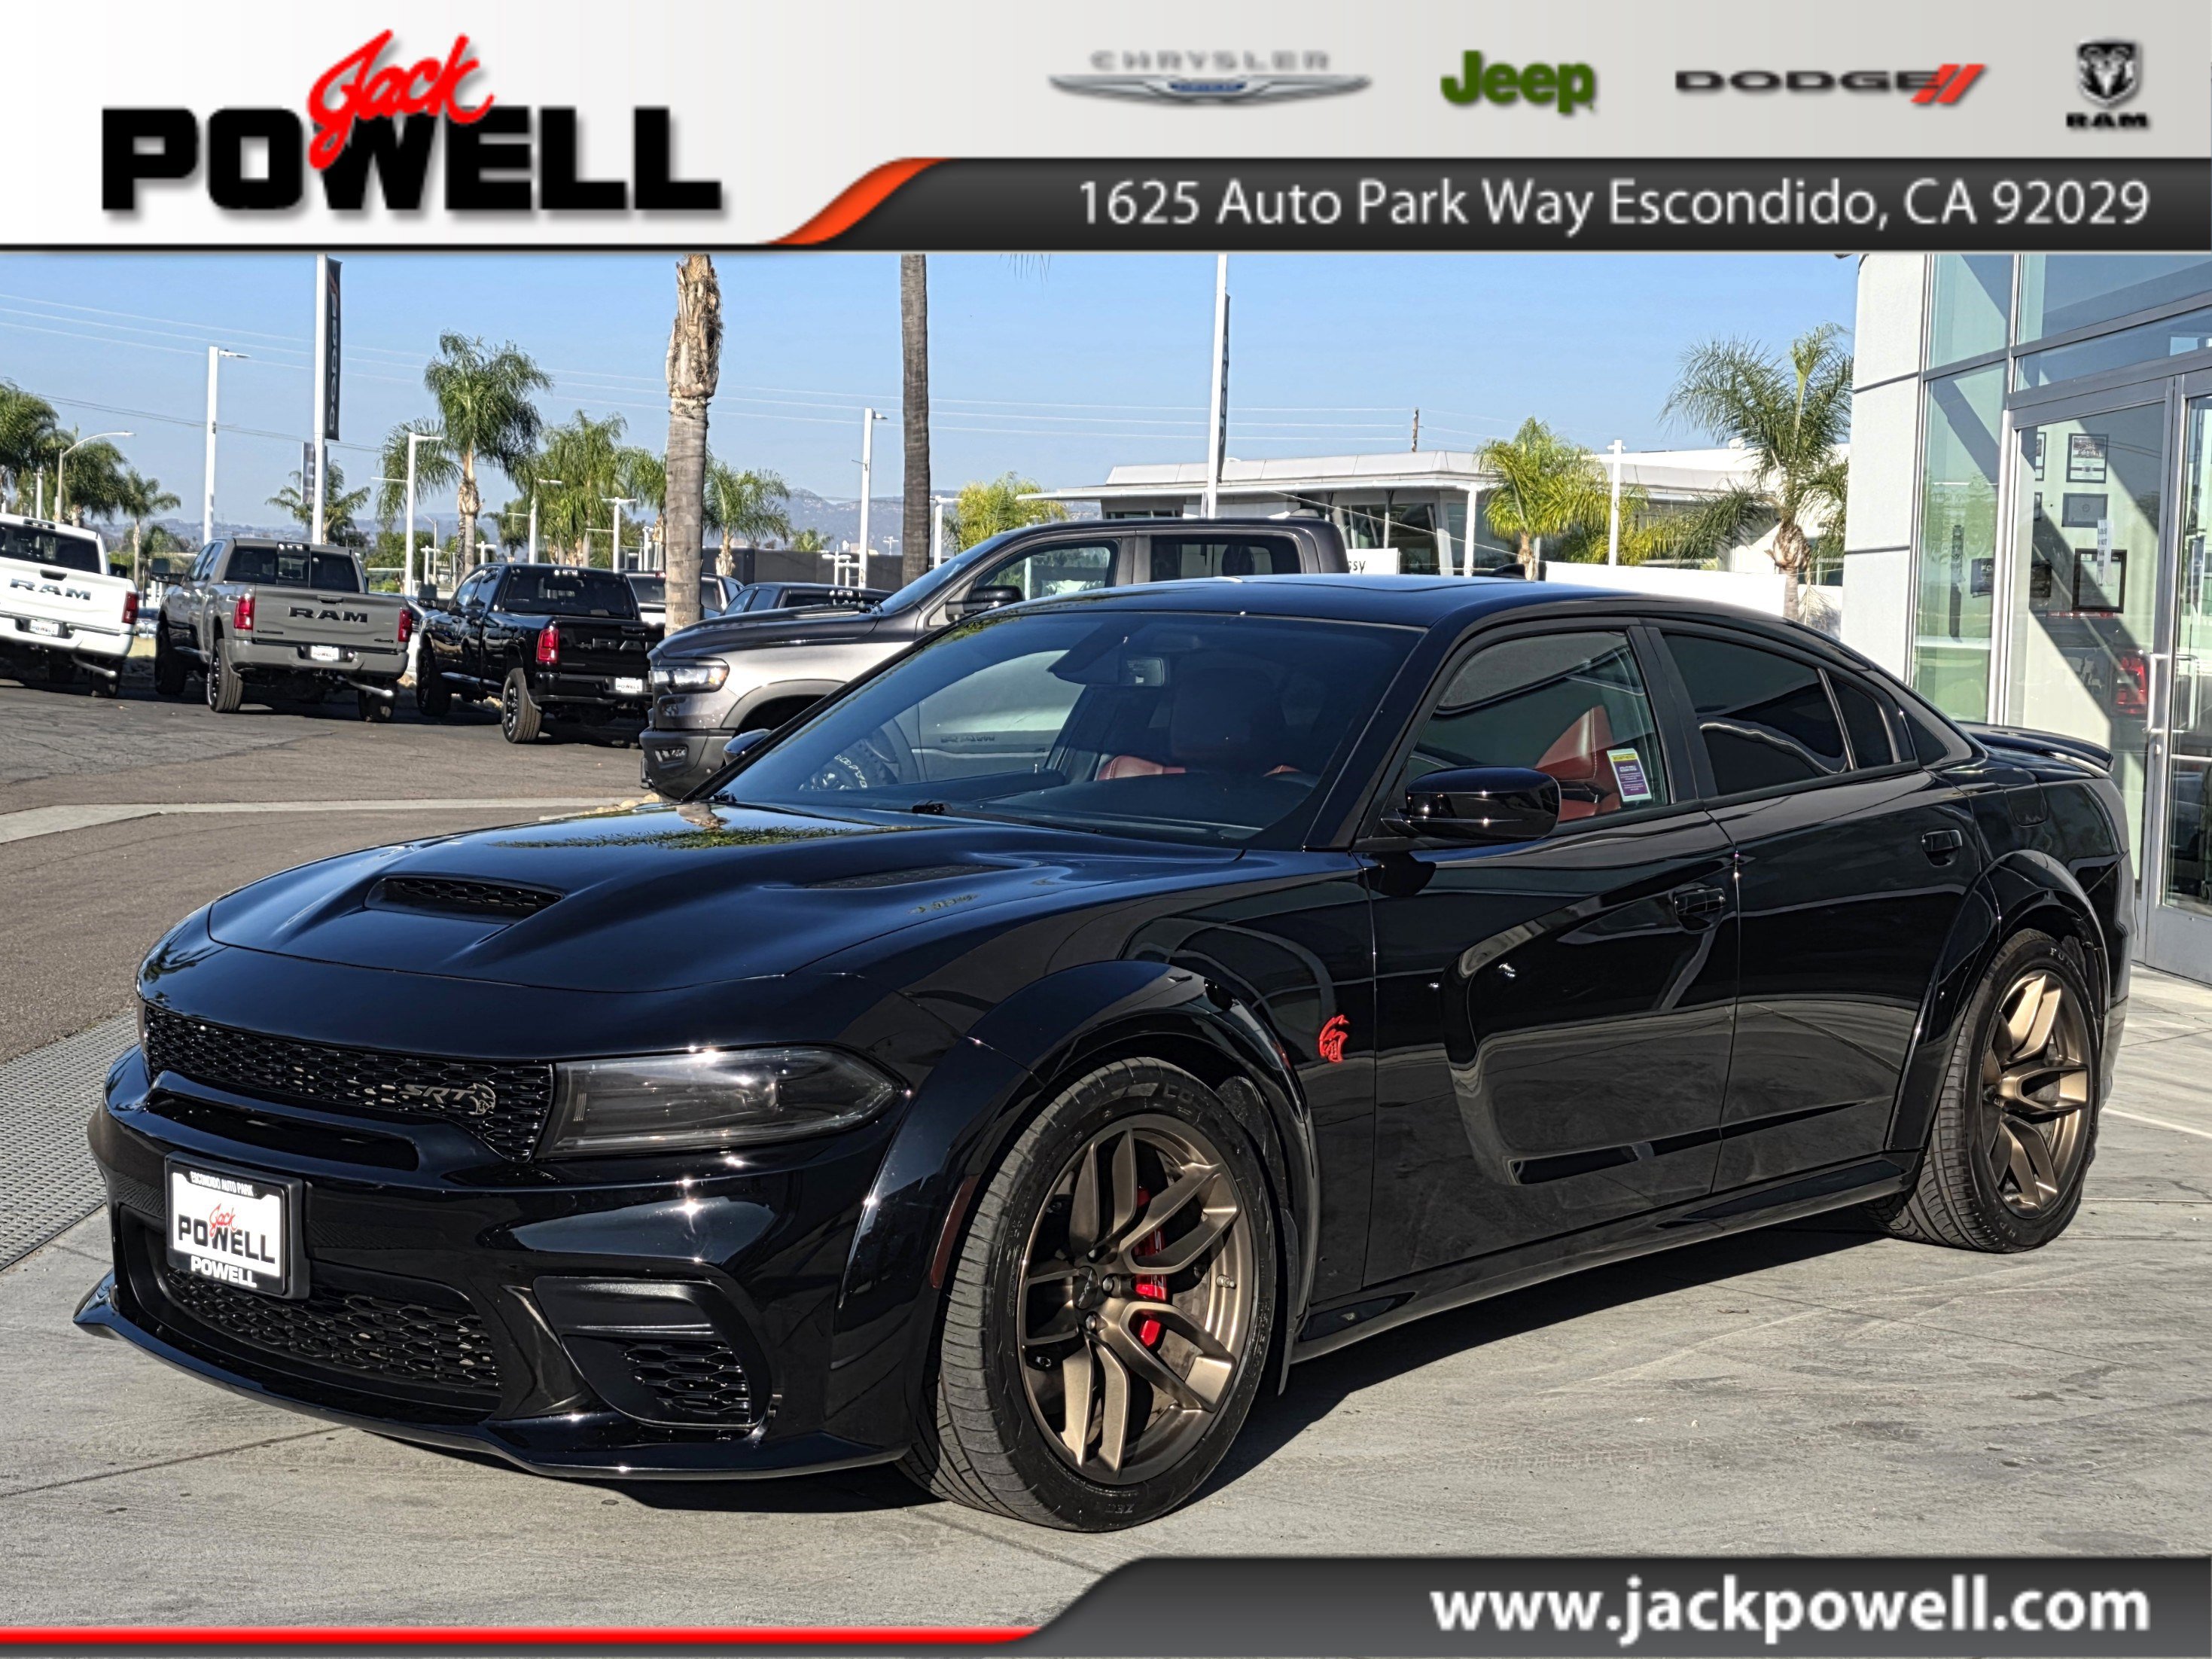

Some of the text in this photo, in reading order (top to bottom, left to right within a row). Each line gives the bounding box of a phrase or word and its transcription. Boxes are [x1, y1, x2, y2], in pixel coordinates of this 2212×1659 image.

[10, 578, 91, 600] RAM
[288, 607, 367, 623] RAM
[398, 1084, 476, 1104] SRT
[190, 1171, 254, 1197] ESCONDIDO AUTO PARK
[209, 1203, 237, 1237] Jack
[178, 1214, 276, 1264] POWELL
[191, 1255, 257, 1288] POWELL
